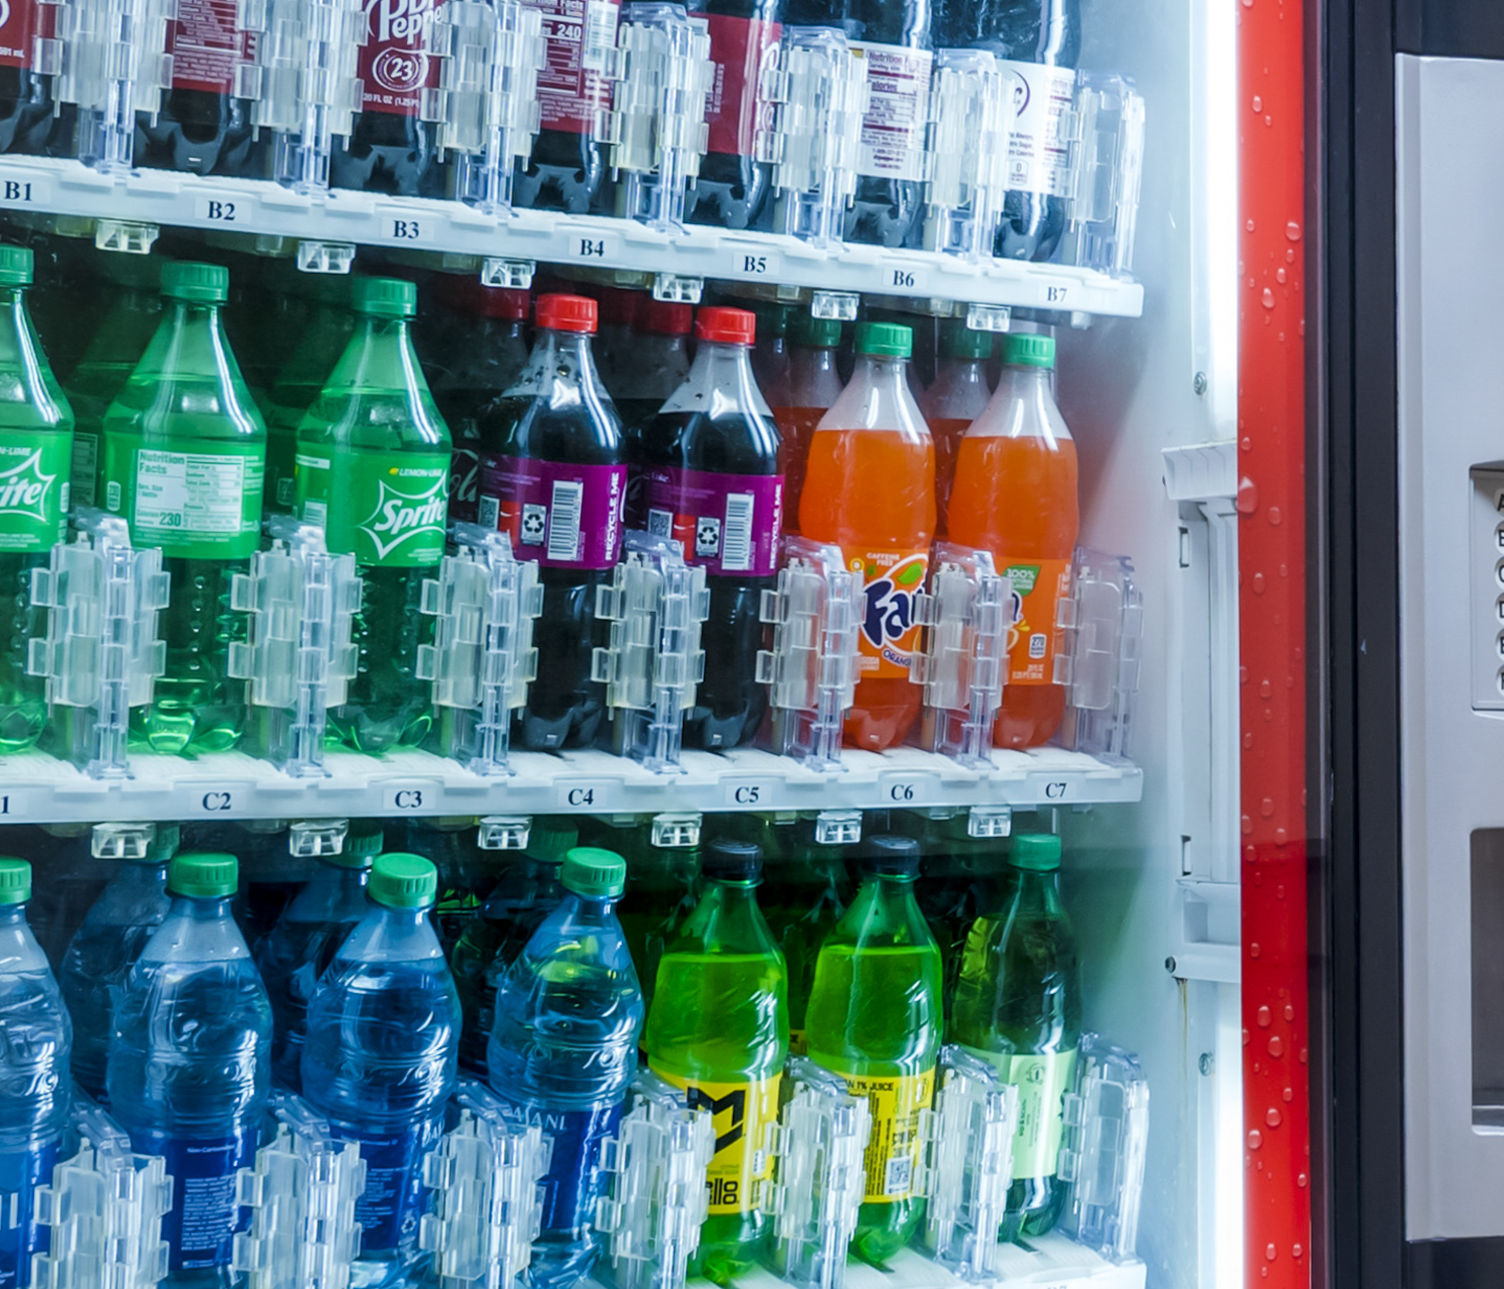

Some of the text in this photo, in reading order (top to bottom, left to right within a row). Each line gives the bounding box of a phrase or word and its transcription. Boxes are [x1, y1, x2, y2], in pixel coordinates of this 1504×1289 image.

[557, 23, 582, 40] 240
[392, 58, 413, 81] 23
[4, 180, 33, 202] B1
[208, 201, 235, 222] B2
[393, 219, 420, 239] B3
[580, 238, 604, 257] B4
[743, 256, 767, 273] B5
[892, 271, 915, 288] B6
[1047, 286, 1067, 303] B7
[140, 451, 185, 465] Nutrition
[139, 462, 167, 475] Facts
[159, 512, 182, 527] 230
[373, 496, 446, 535] Sprite
[605, 472, 620, 561] RECYCLE ME
[866, 552, 901, 562] CAFFEINE
[877, 559, 894, 567] FREE
[1007, 568, 1036, 579] 100%
[567, 788, 594, 806] C4
[735, 786, 760, 803] C5
[891, 784, 914, 801] C6
[1045, 781, 1068, 798] C7
[202, 792, 232, 811] C2
[394, 790, 423, 808] C3
